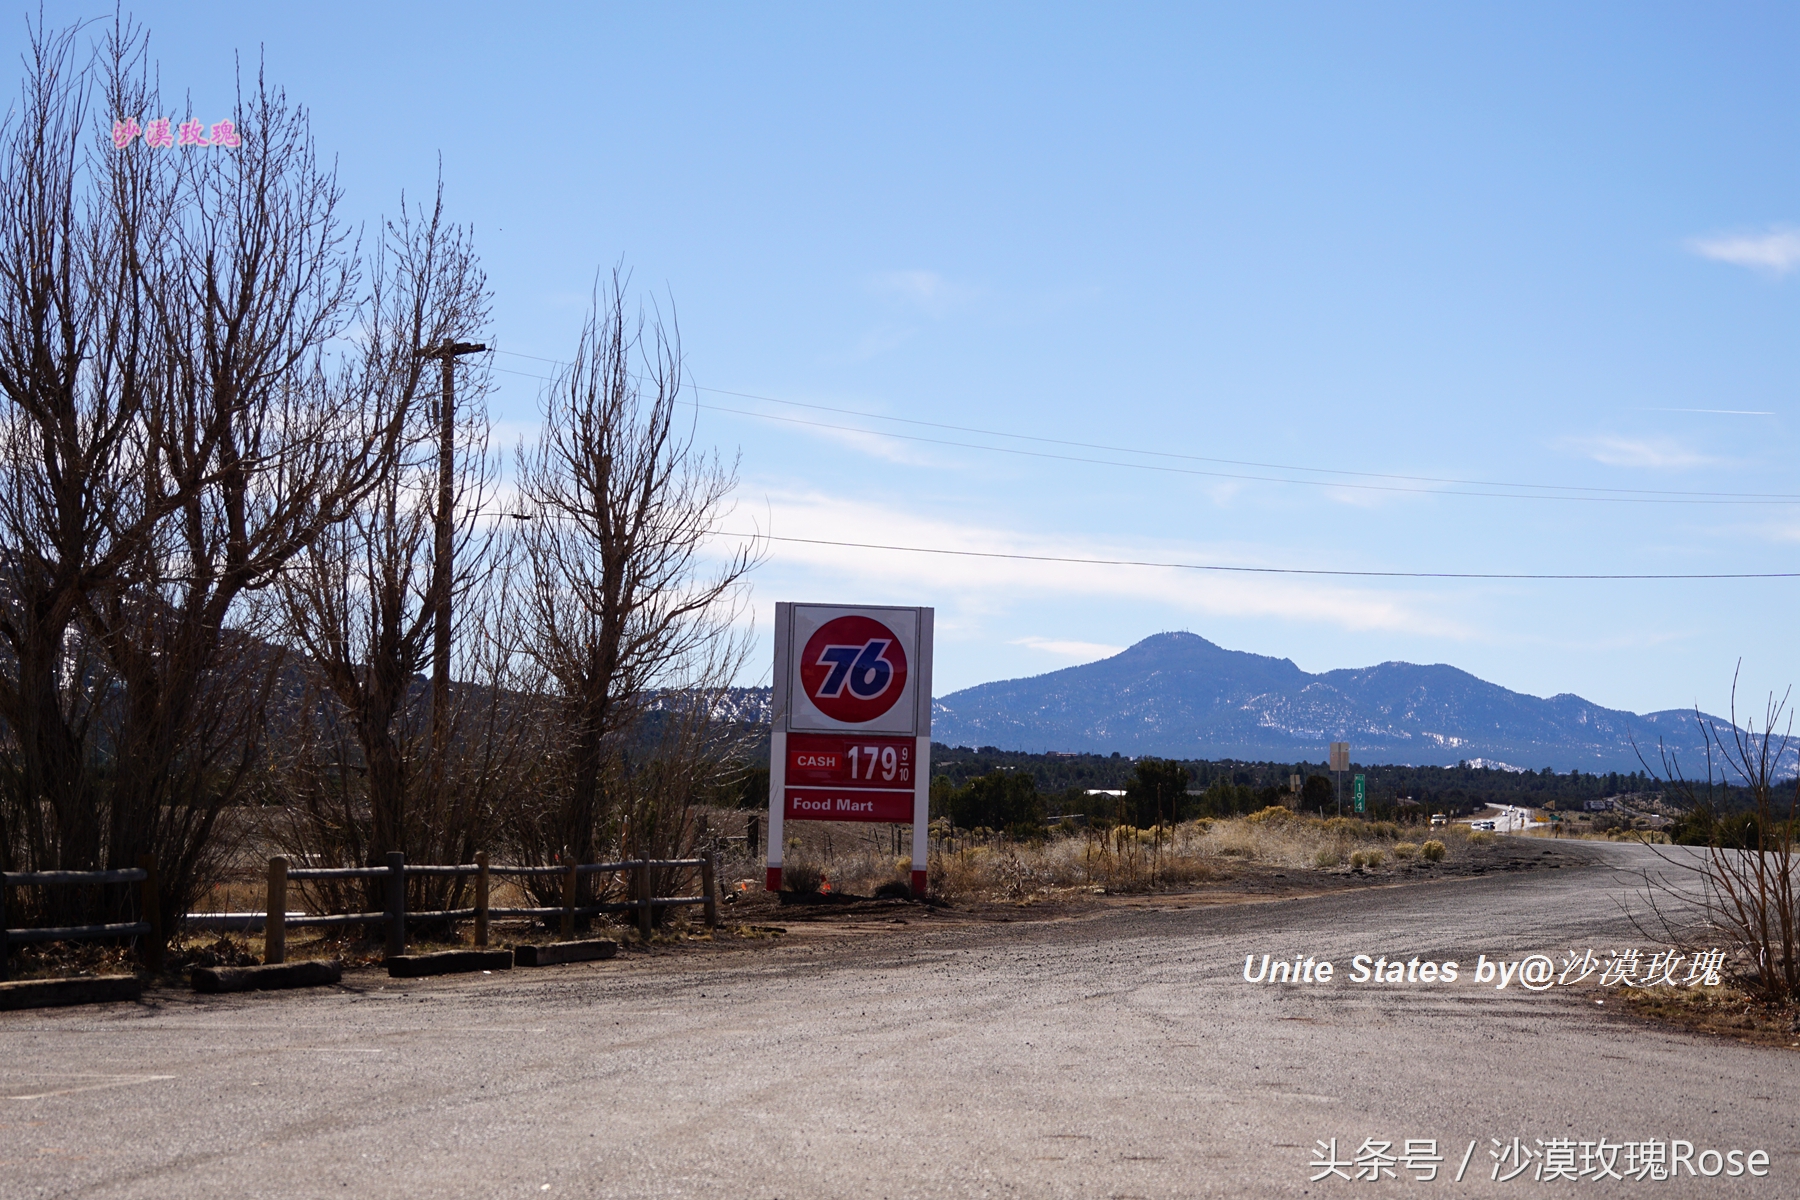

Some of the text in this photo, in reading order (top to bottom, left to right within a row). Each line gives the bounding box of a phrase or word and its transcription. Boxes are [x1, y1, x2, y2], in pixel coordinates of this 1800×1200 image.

[815, 638, 894, 700] 76
[797, 746, 897, 781] CASH 179
[793, 798, 873, 812] Food Mart
